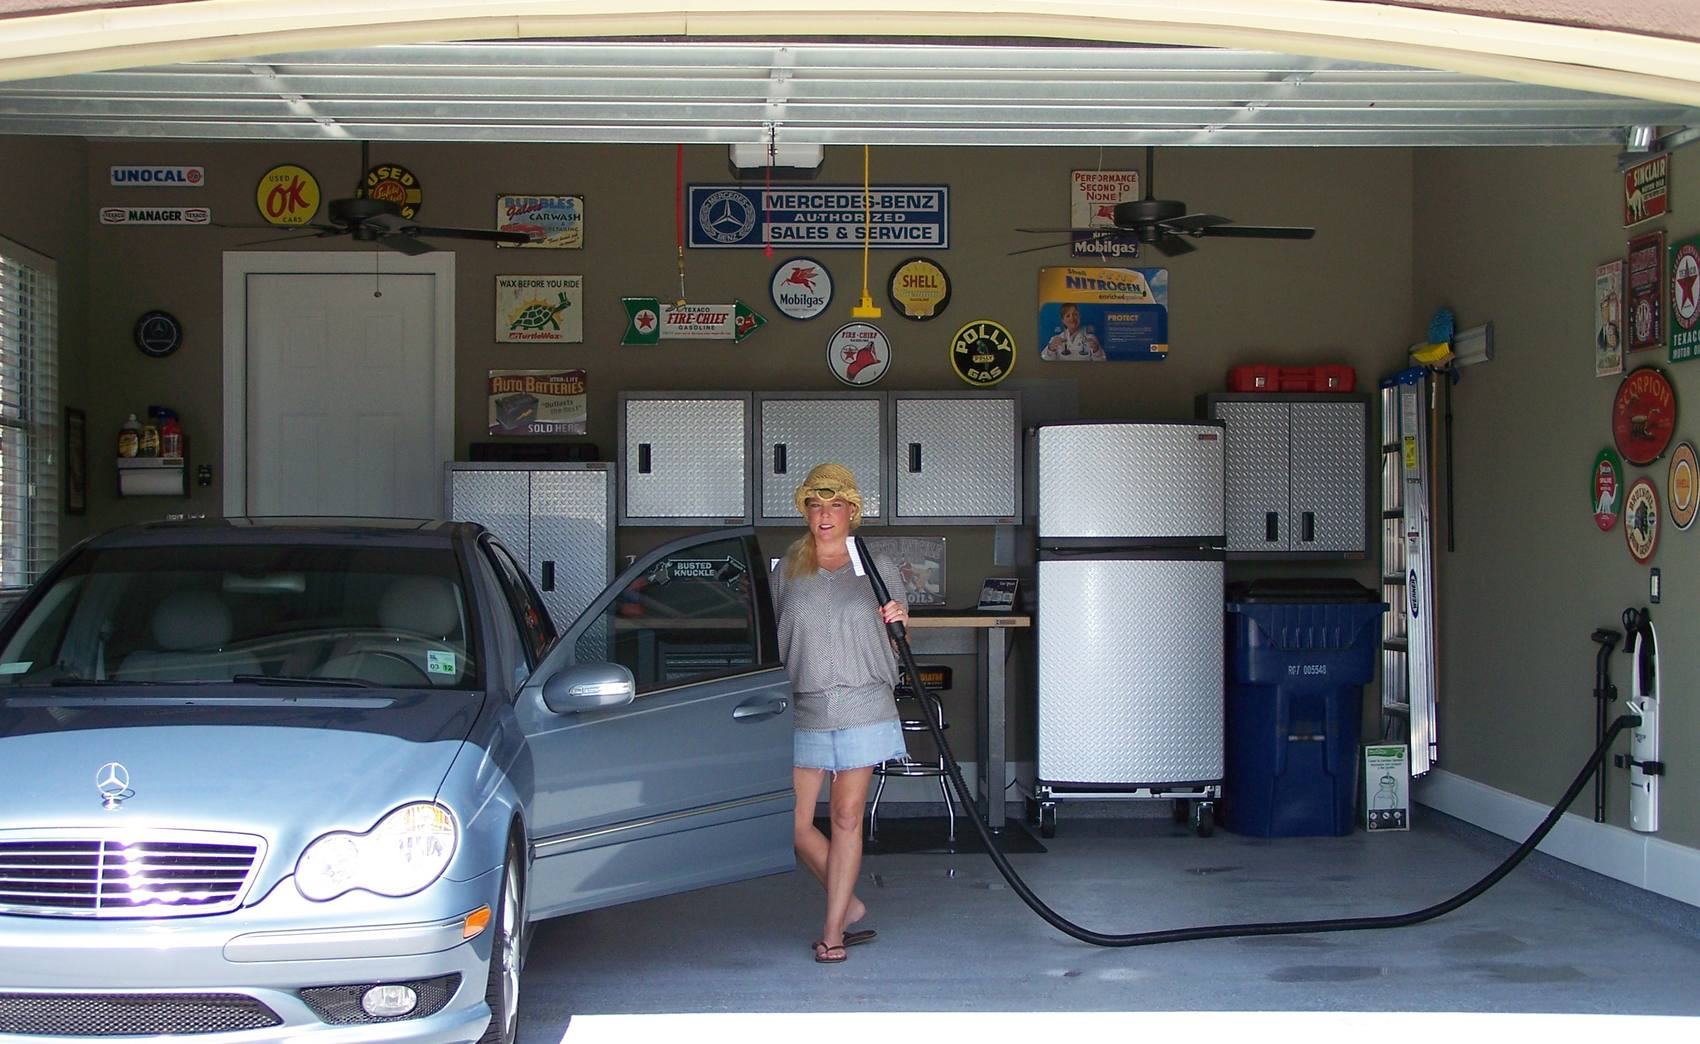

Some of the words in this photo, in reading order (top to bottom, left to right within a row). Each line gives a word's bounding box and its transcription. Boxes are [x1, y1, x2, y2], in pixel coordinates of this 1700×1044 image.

[113, 169, 187, 182] UNOCAL
[367, 168, 414, 187] USED
[1074, 172, 1137, 183] PERFORMANCE
[1633, 159, 1666, 187] SINCLAIR
[1080, 182, 1116, 192] SECOND
[1118, 183, 1130, 192] TO
[266, 174, 310, 218] OK
[766, 195, 935, 210] MERCEDES-BENZ
[128, 210, 182, 221] MANAGER
[794, 213, 906, 223] AUTHORZED
[770, 226, 835, 240] SALES
[836, 227, 849, 240] &
[855, 226, 932, 240] SERVICE
[1074, 240, 1136, 257] Mobilgas
[499, 280, 518, 288] WAX
[518, 280, 545, 288] BEFORE
[546, 280, 562, 288] YOU
[564, 280, 580, 288] RIDE
[902, 274, 938, 289] SHELL
[1065, 275, 1141, 292] NITROGEN
[780, 293, 824, 308] Mobilgas
[667, 313, 729, 325] FIRE-CHIEF
[956, 324, 1012, 354] POLLY
[967, 366, 1002, 380] GAS
[525, 376, 585, 395] BATTERIES
[528, 423, 553, 433] SOLD
[674, 569, 715, 577] KNUCKLE
[677, 562, 712, 570] BUSTED
